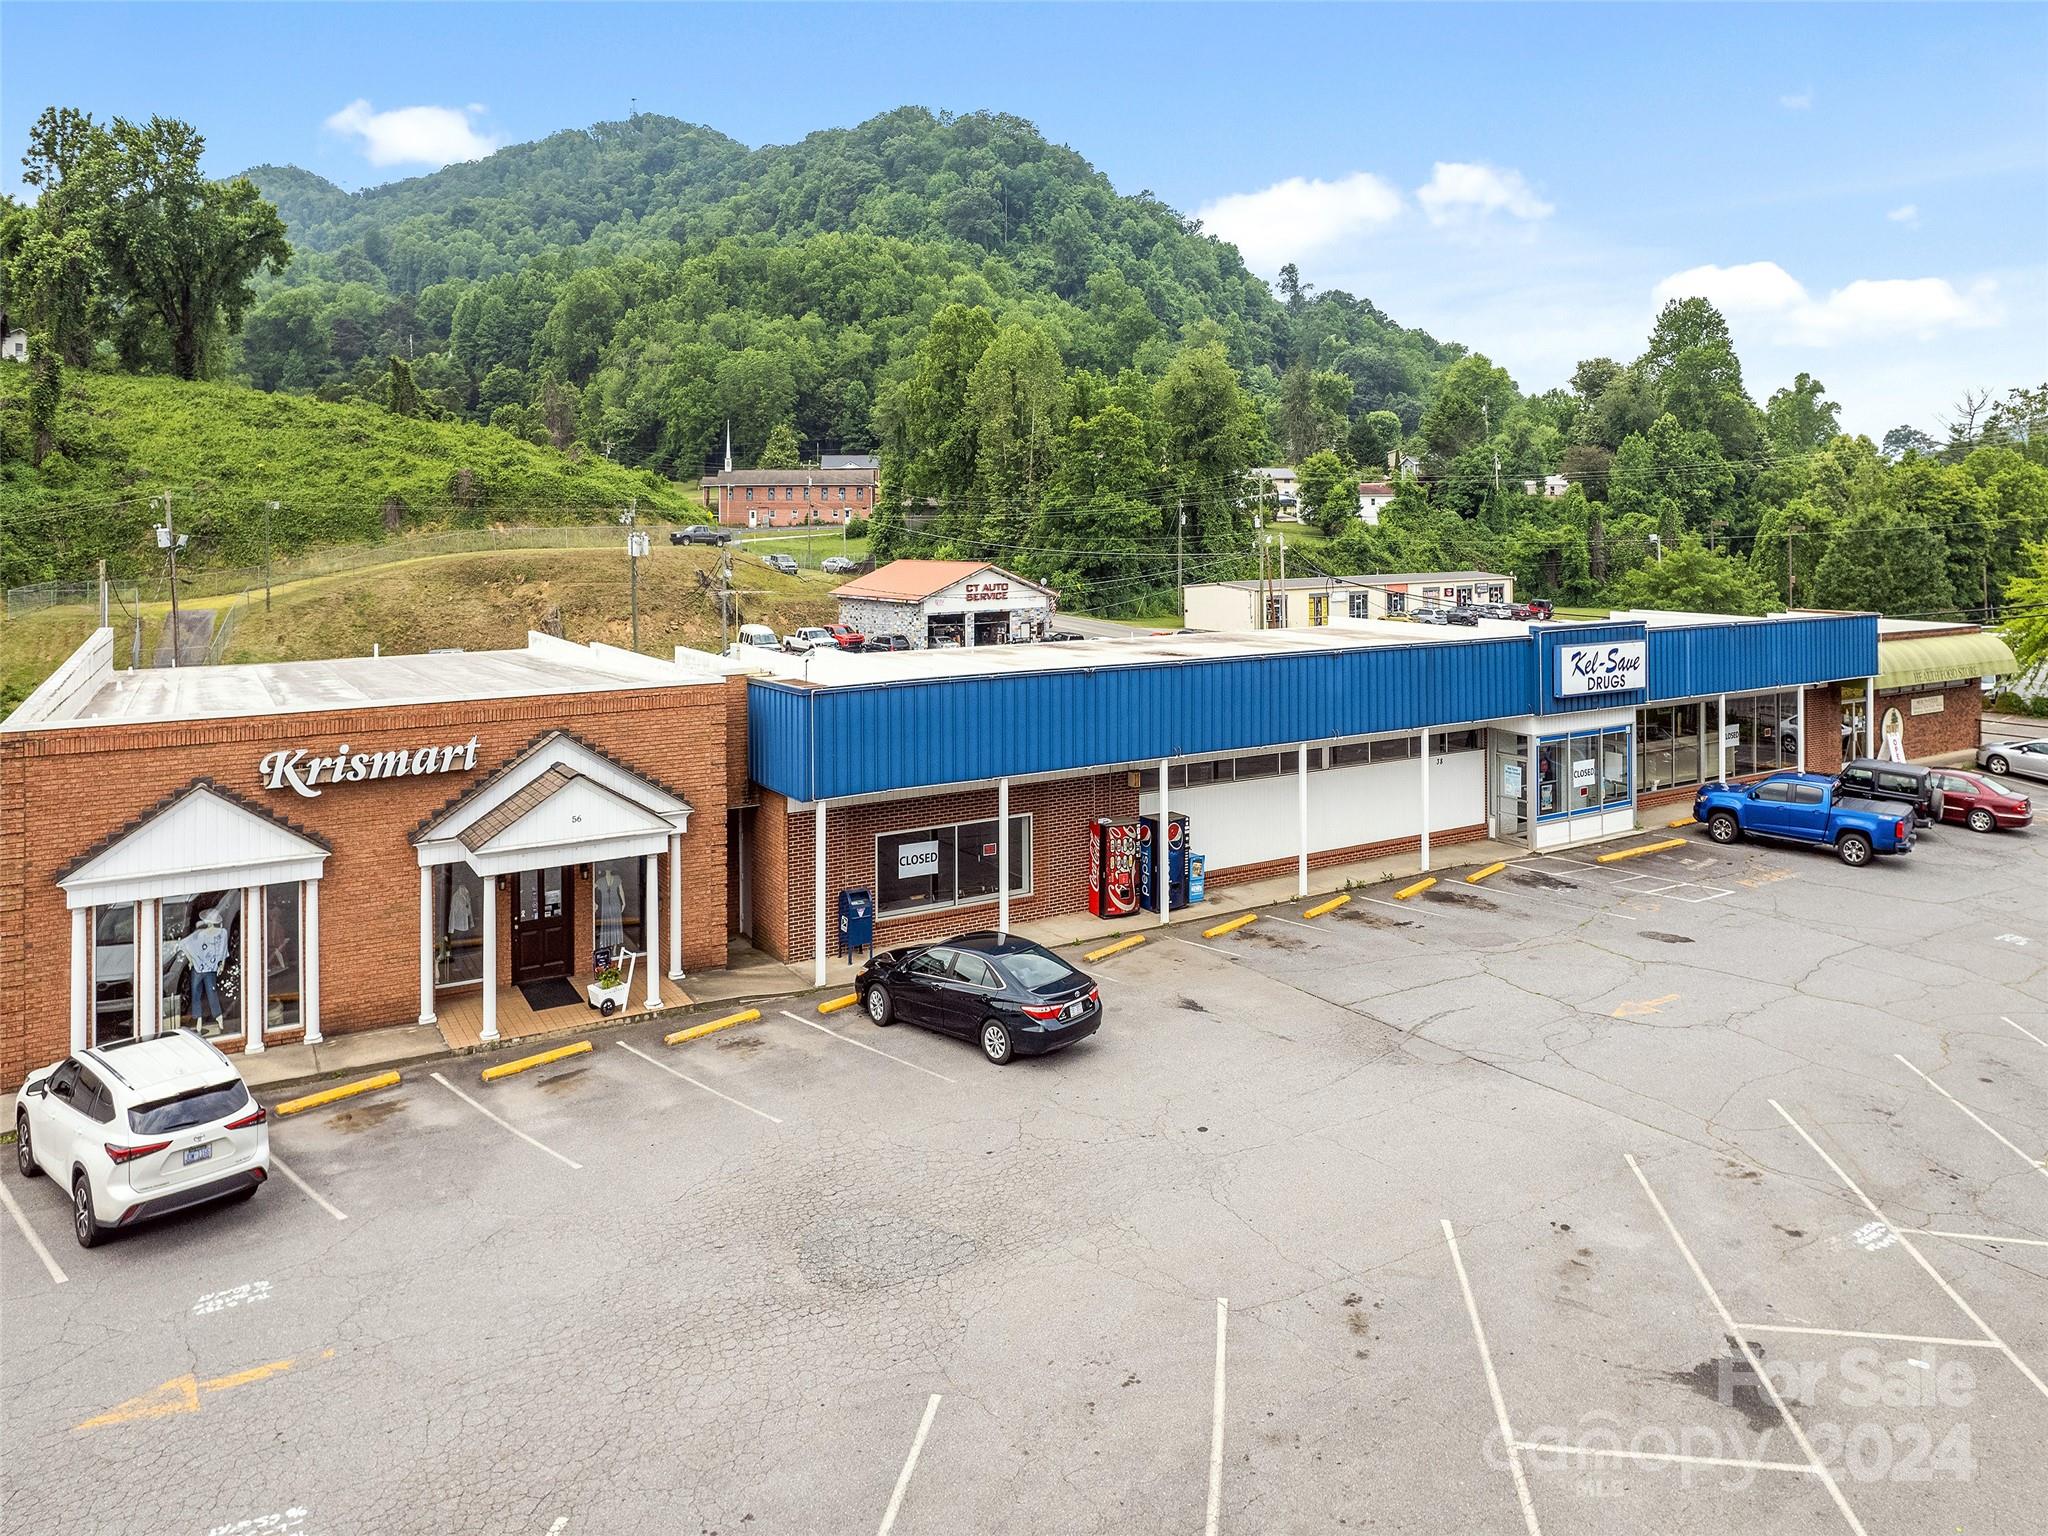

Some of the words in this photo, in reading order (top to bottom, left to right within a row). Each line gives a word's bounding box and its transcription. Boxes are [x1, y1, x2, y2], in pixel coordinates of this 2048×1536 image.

[966, 584, 979, 592] CT
[982, 583, 1008, 591] AUTO
[966, 592, 1008, 601] SERVICE
[1571, 648, 1640, 677] Kel-Save
[1587, 674, 1626, 690] DRUGS
[1913, 671, 1939, 683] HEALTH
[1725, 731, 1739, 740] LOSED
[259, 735, 481, 797] Krismart
[1573, 767, 1595, 779] CLOSED
[571, 815, 582, 823] 56
[899, 852, 938, 867] CLOSED
